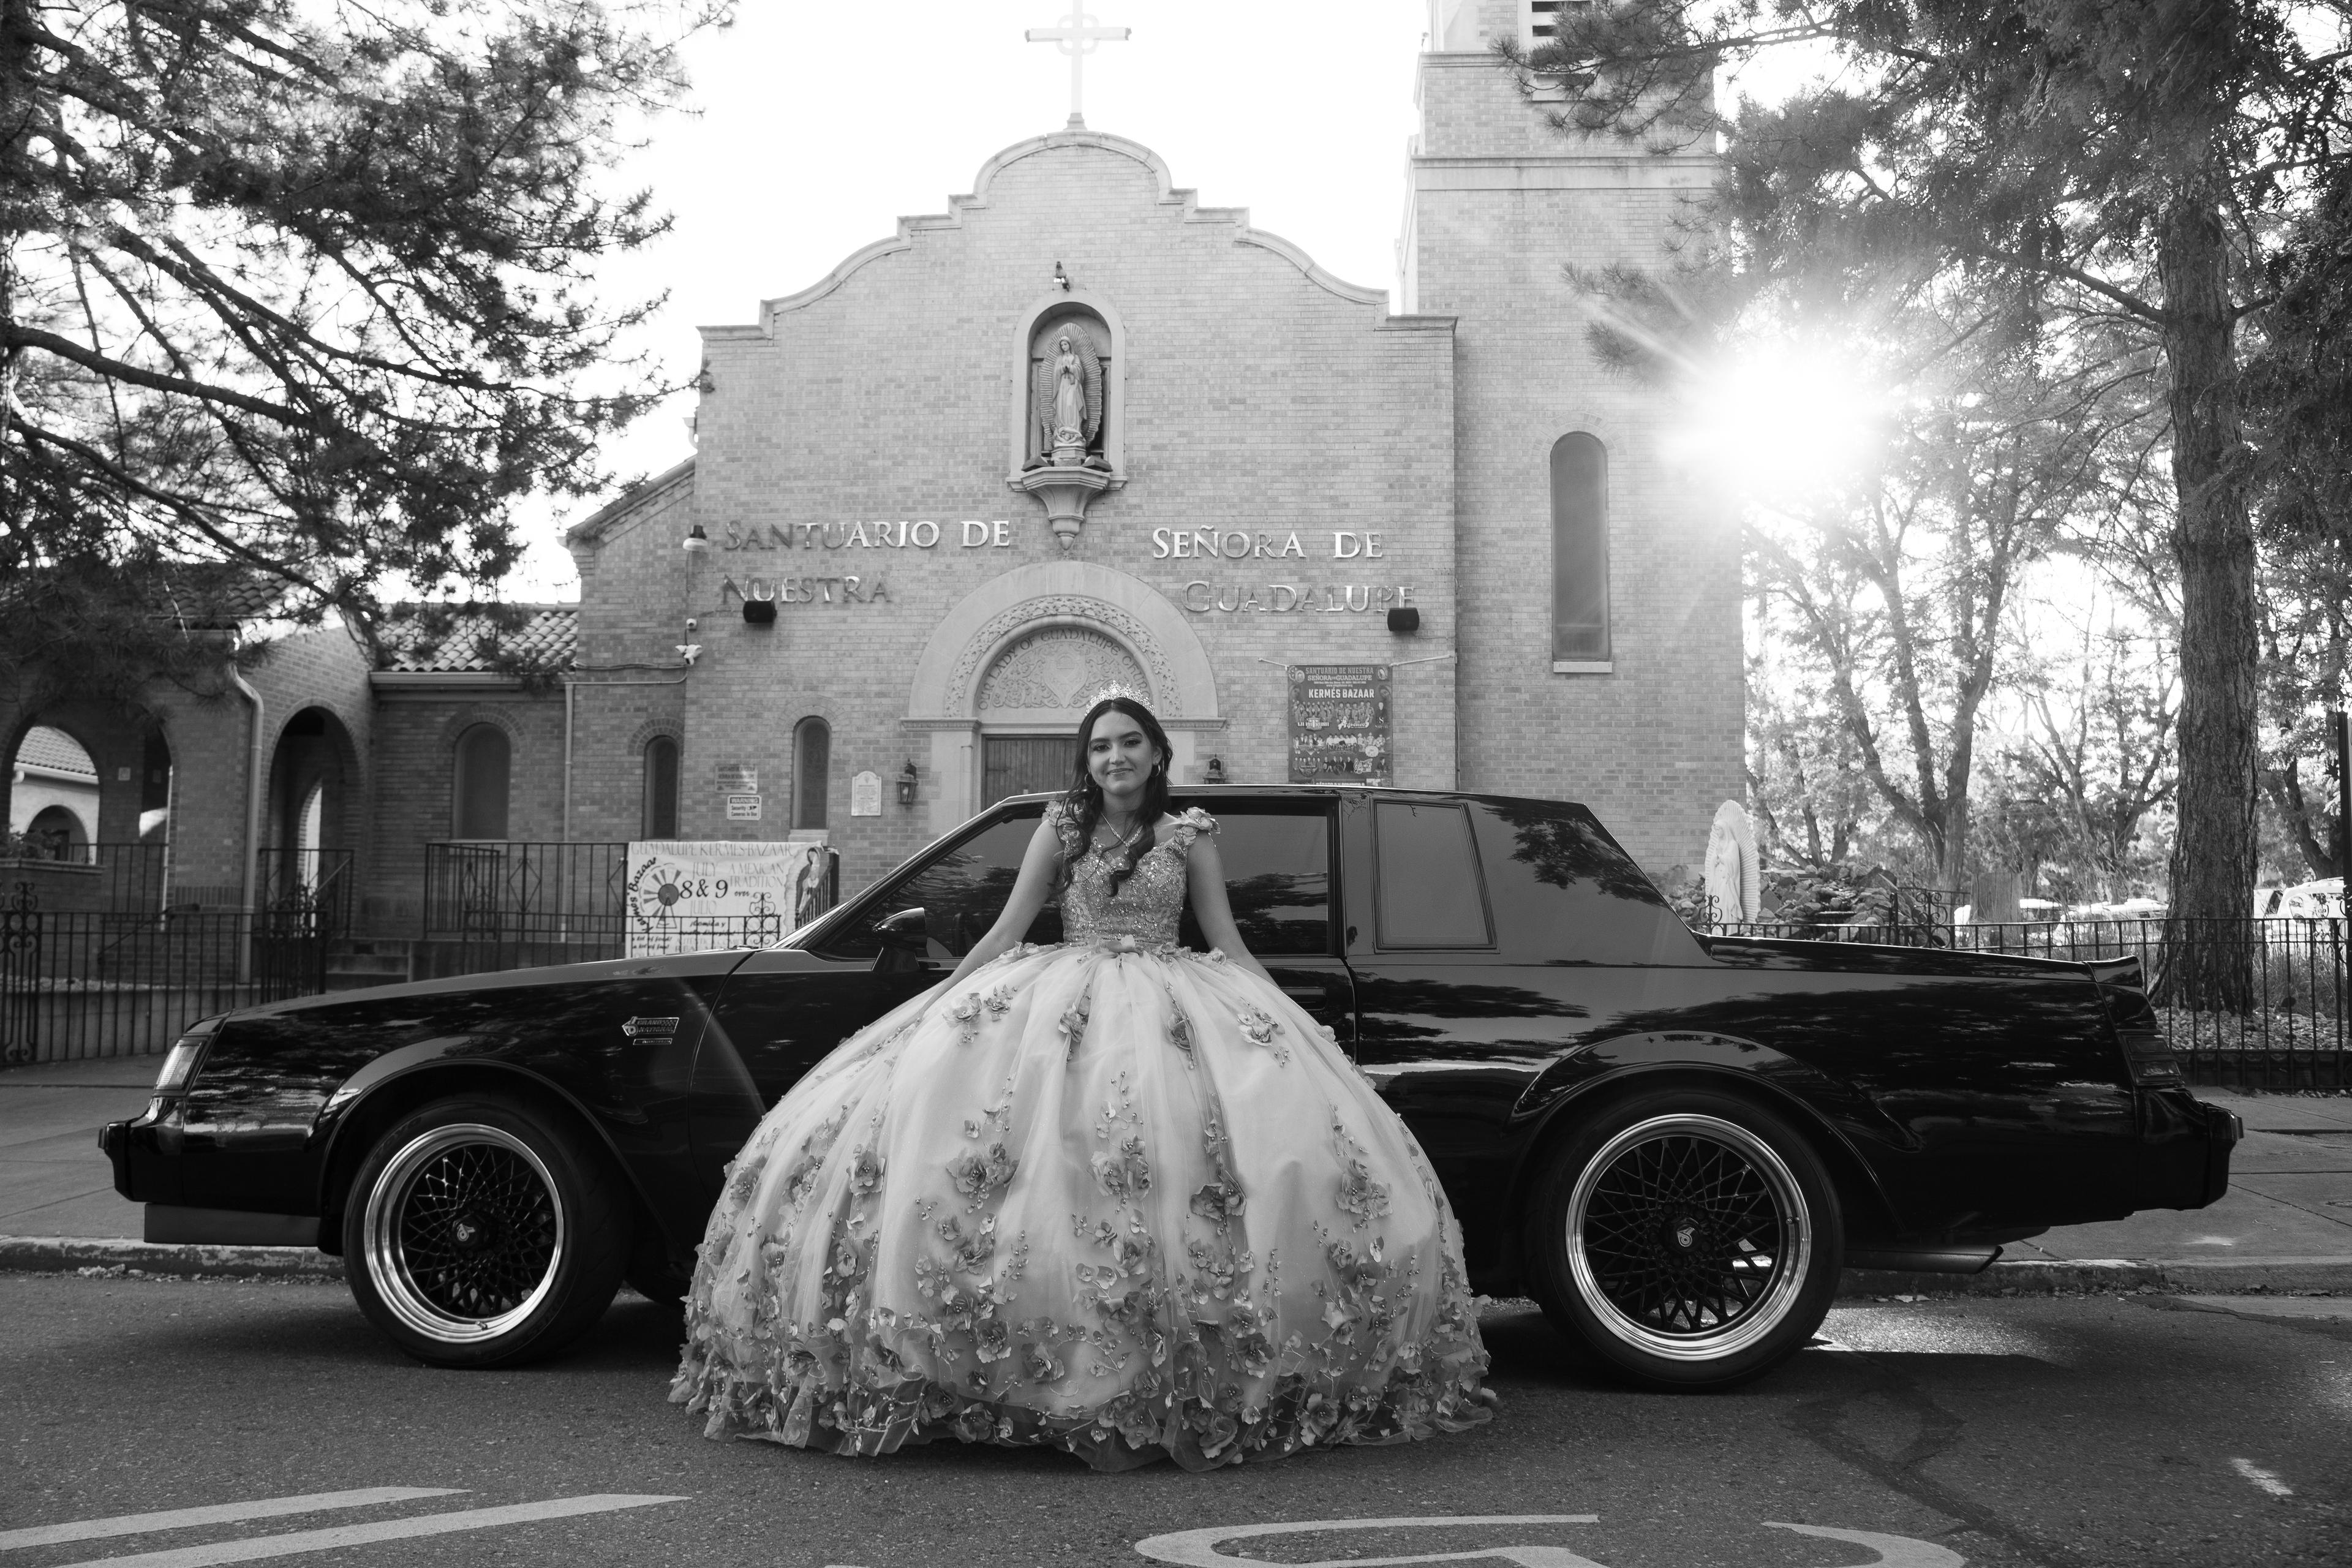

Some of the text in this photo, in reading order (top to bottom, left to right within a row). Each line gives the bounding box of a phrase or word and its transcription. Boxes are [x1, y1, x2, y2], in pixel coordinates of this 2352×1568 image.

[725, 519, 1010, 549] SANTUARIO DE
[1152, 524, 1383, 559] SEÑORA DE
[723, 573, 892, 603] NUESTRA
[978, 683, 994, 710] OUR
[988, 647, 1017, 680] LADY
[1020, 637, 1036, 650] OF
[1308, 687, 1374, 698] KERMÉS BAZAAR
[631, 843, 696, 856] GUADALUPE
[692, 862, 715, 880] JULY
[739, 862, 785, 875] MEXICAN
[680, 879, 728, 899] 8 & 9
[729, 875, 784, 888] TRADITION
